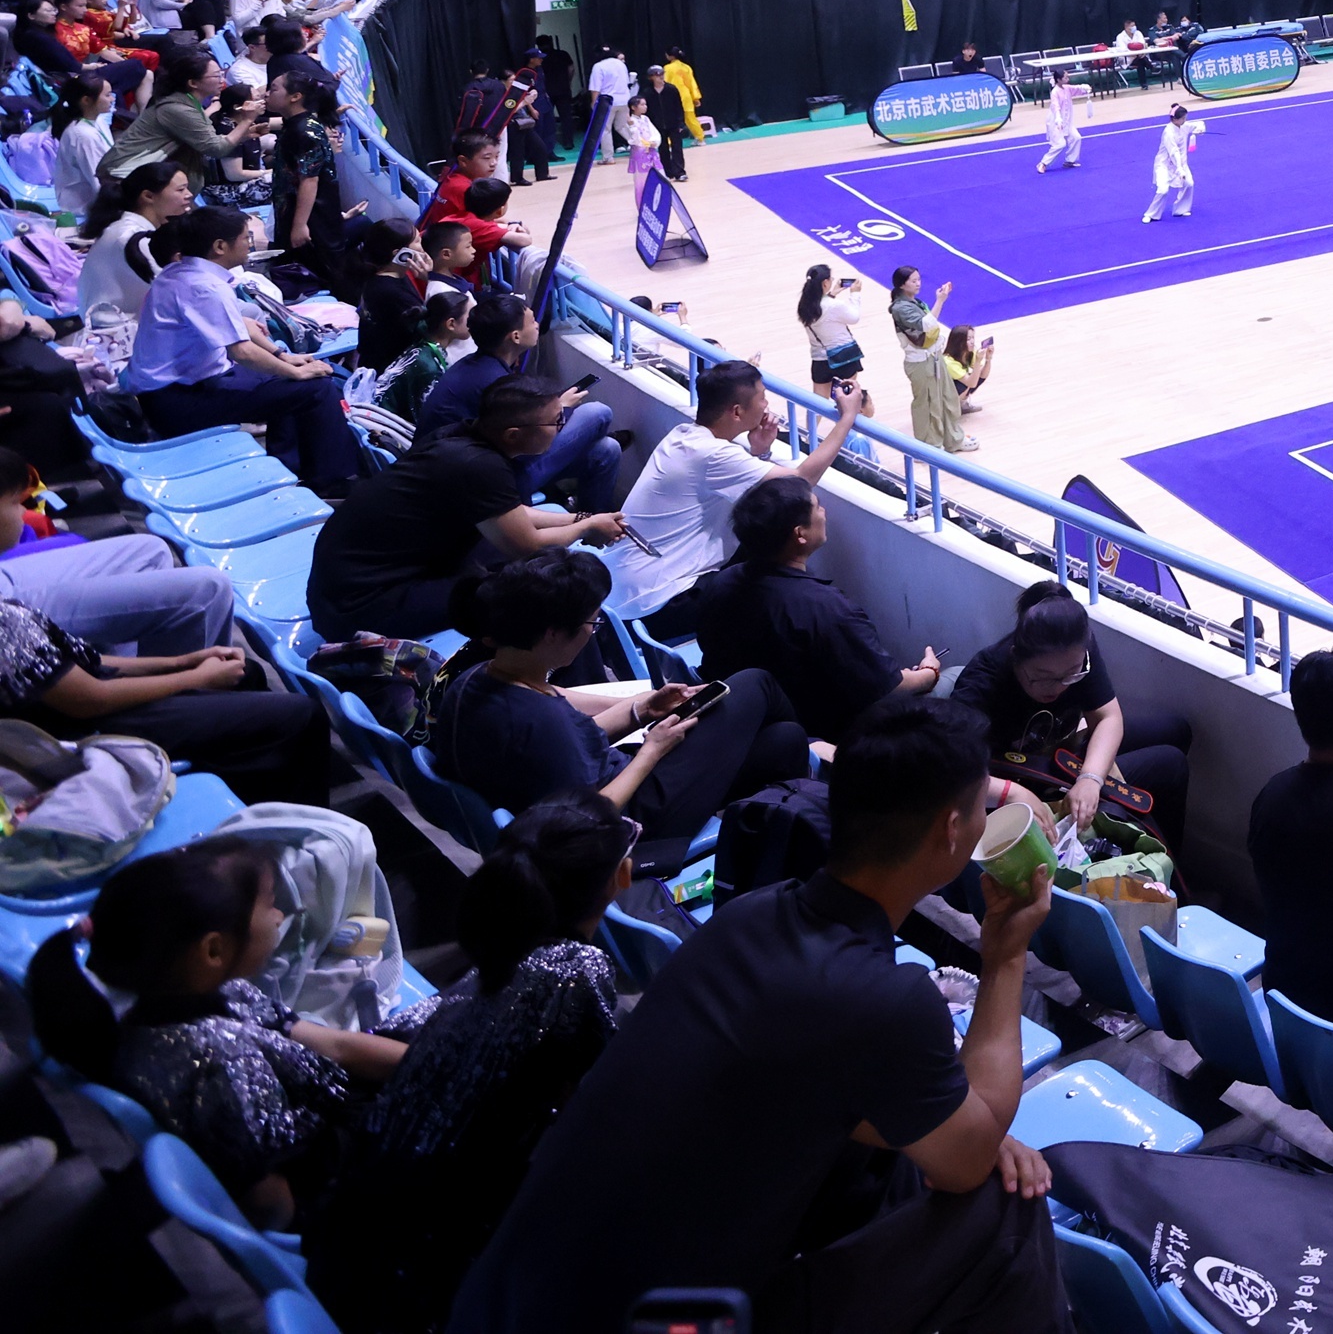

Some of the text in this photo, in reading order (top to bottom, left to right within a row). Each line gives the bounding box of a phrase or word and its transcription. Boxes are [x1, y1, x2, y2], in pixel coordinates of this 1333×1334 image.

[1191, 47, 1294, 80] 北京市教育委员会
[876, 85, 1009, 122] 北京市武术运动协会
